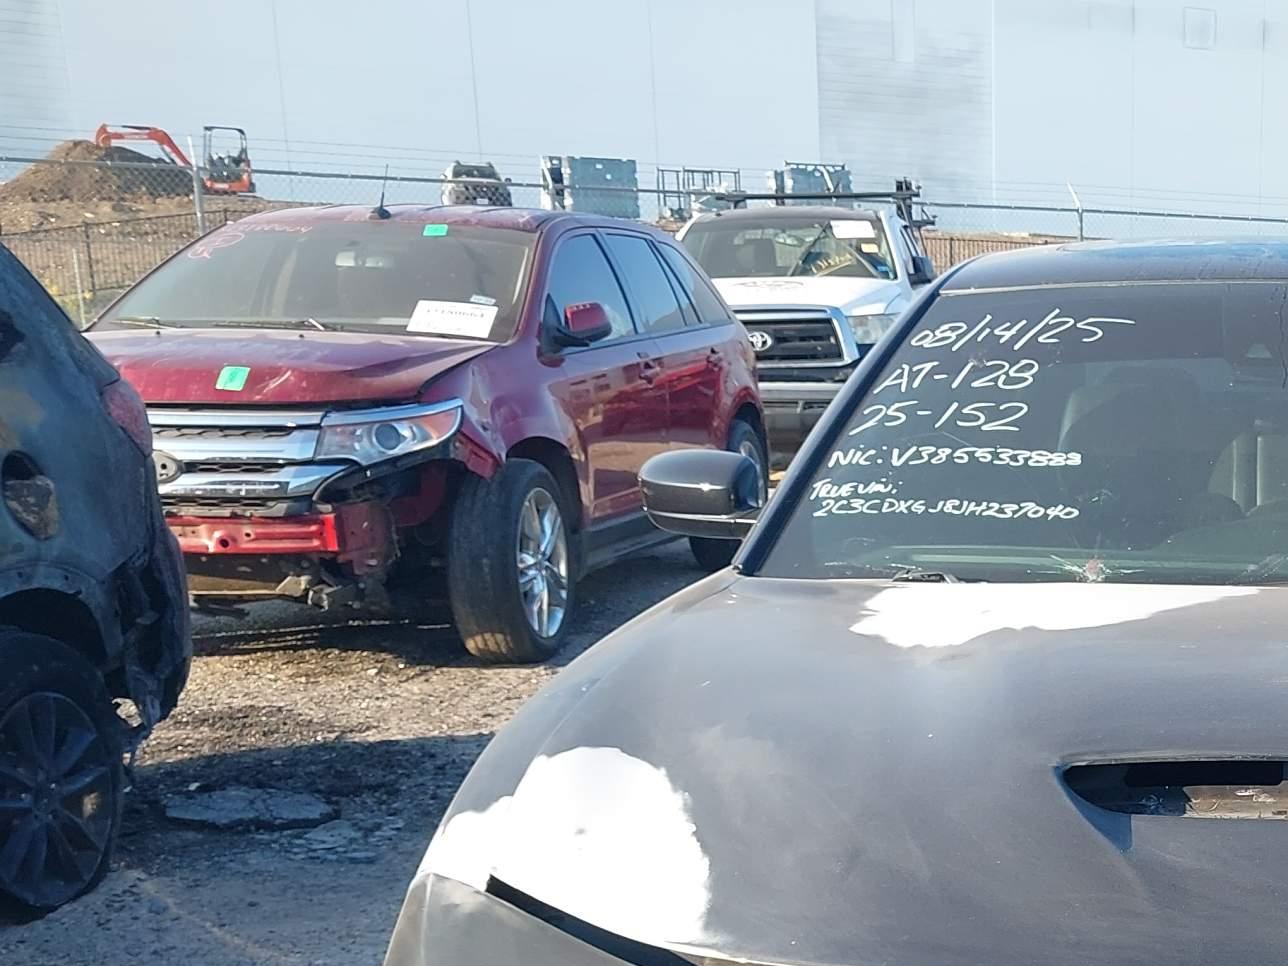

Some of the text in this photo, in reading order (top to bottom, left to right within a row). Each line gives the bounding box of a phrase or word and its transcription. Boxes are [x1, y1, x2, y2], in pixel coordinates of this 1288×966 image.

[911, 308, 1136, 350] 08/14/25
[873, 359, 1040, 394] AT-128
[849, 401, 1029, 435] 25-152
